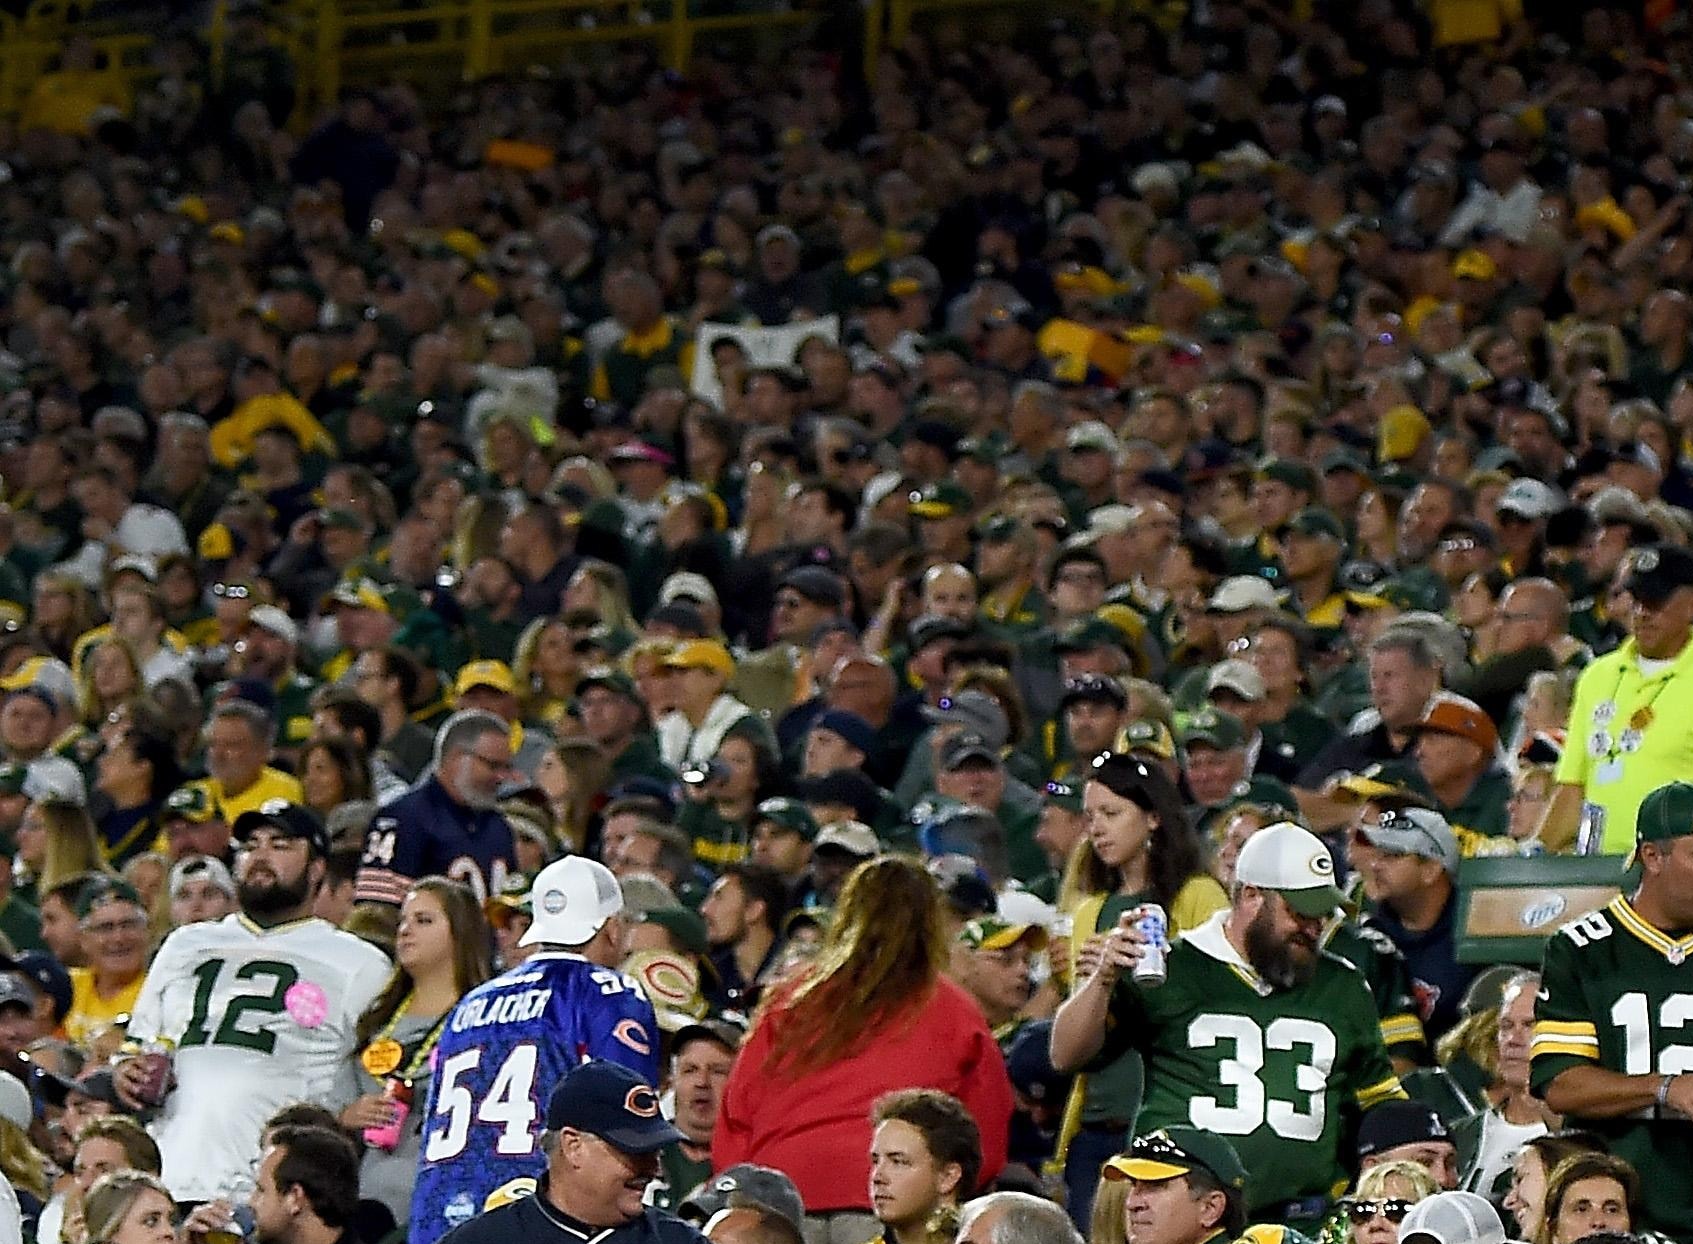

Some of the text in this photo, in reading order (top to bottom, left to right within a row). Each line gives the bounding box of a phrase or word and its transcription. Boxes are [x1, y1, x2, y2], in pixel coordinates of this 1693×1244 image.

[179, 958, 300, 1054] 12
[425, 1043, 538, 1162] 54
[623, 1084, 660, 1118] C
[1187, 1013, 1337, 1142] 33
